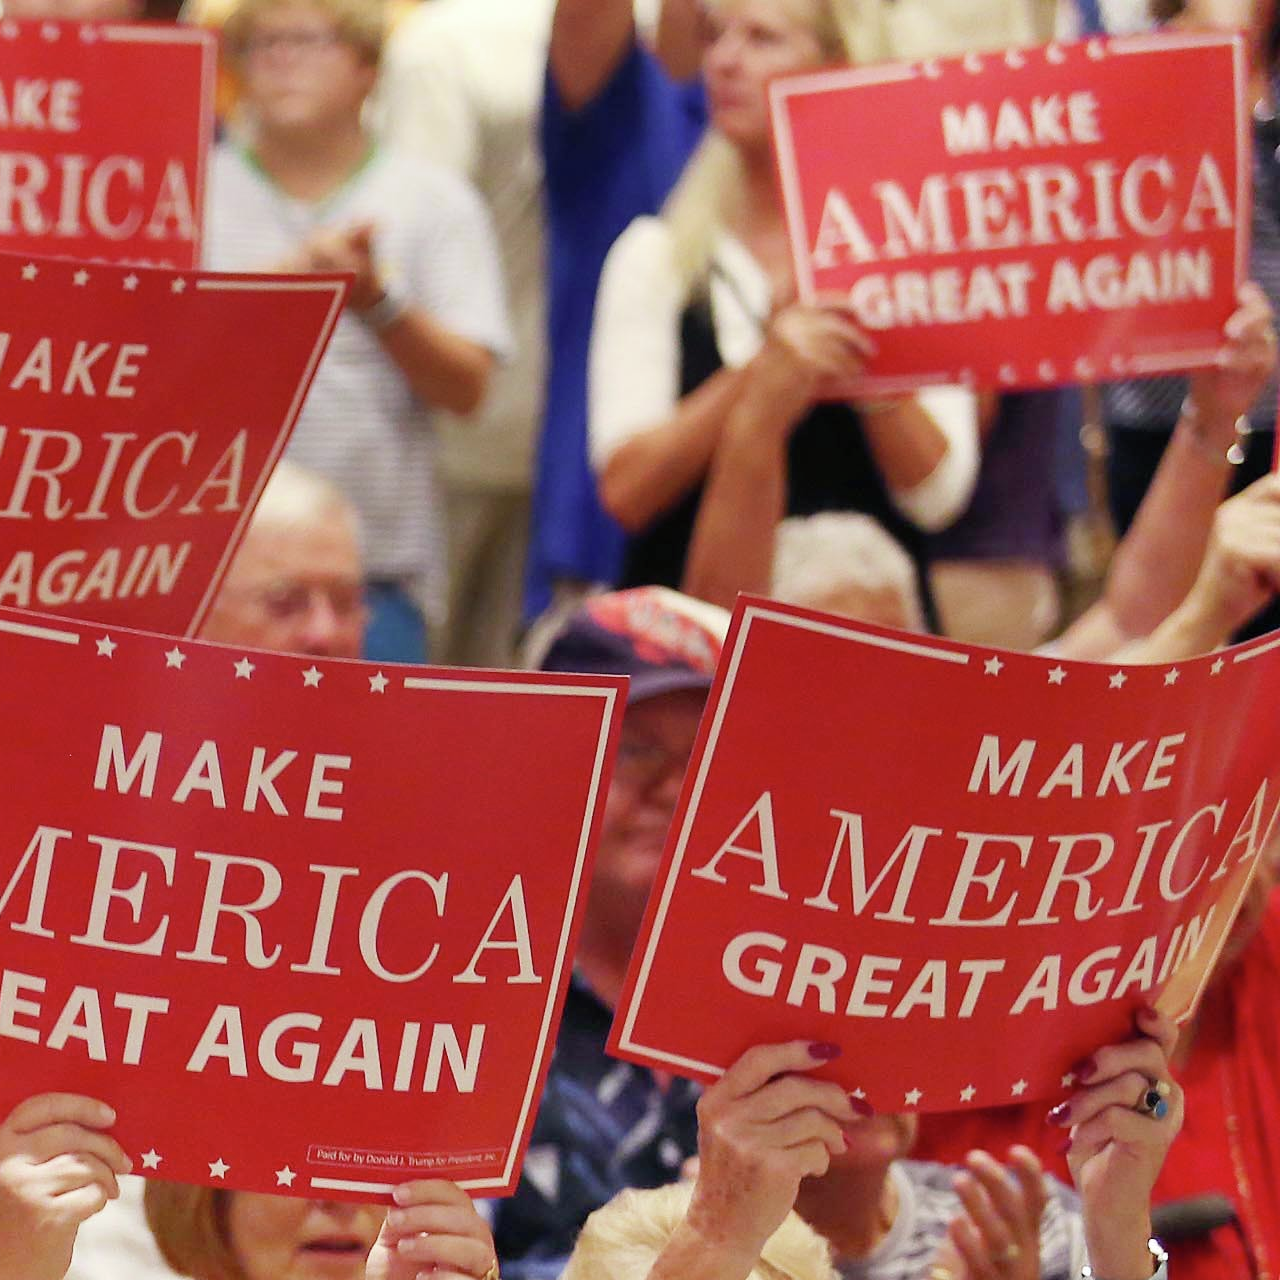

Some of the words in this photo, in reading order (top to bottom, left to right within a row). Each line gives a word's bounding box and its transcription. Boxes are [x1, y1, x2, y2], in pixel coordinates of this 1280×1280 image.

[941, 91, 1103, 156] MAKE
[810, 152, 1234, 269] AMERICA
[848, 260, 1037, 330] GREAT
[1046, 247, 1213, 313] AGAIN
[93, 725, 351, 822] MAKE
[966, 732, 1186, 798] MAKE
[691, 777, 1268, 928] AMERICA
[721, 931, 1003, 1019] GREAT
[1009, 903, 1217, 1015] AGAIN
[186, 1004, 485, 1094] AGAIN
